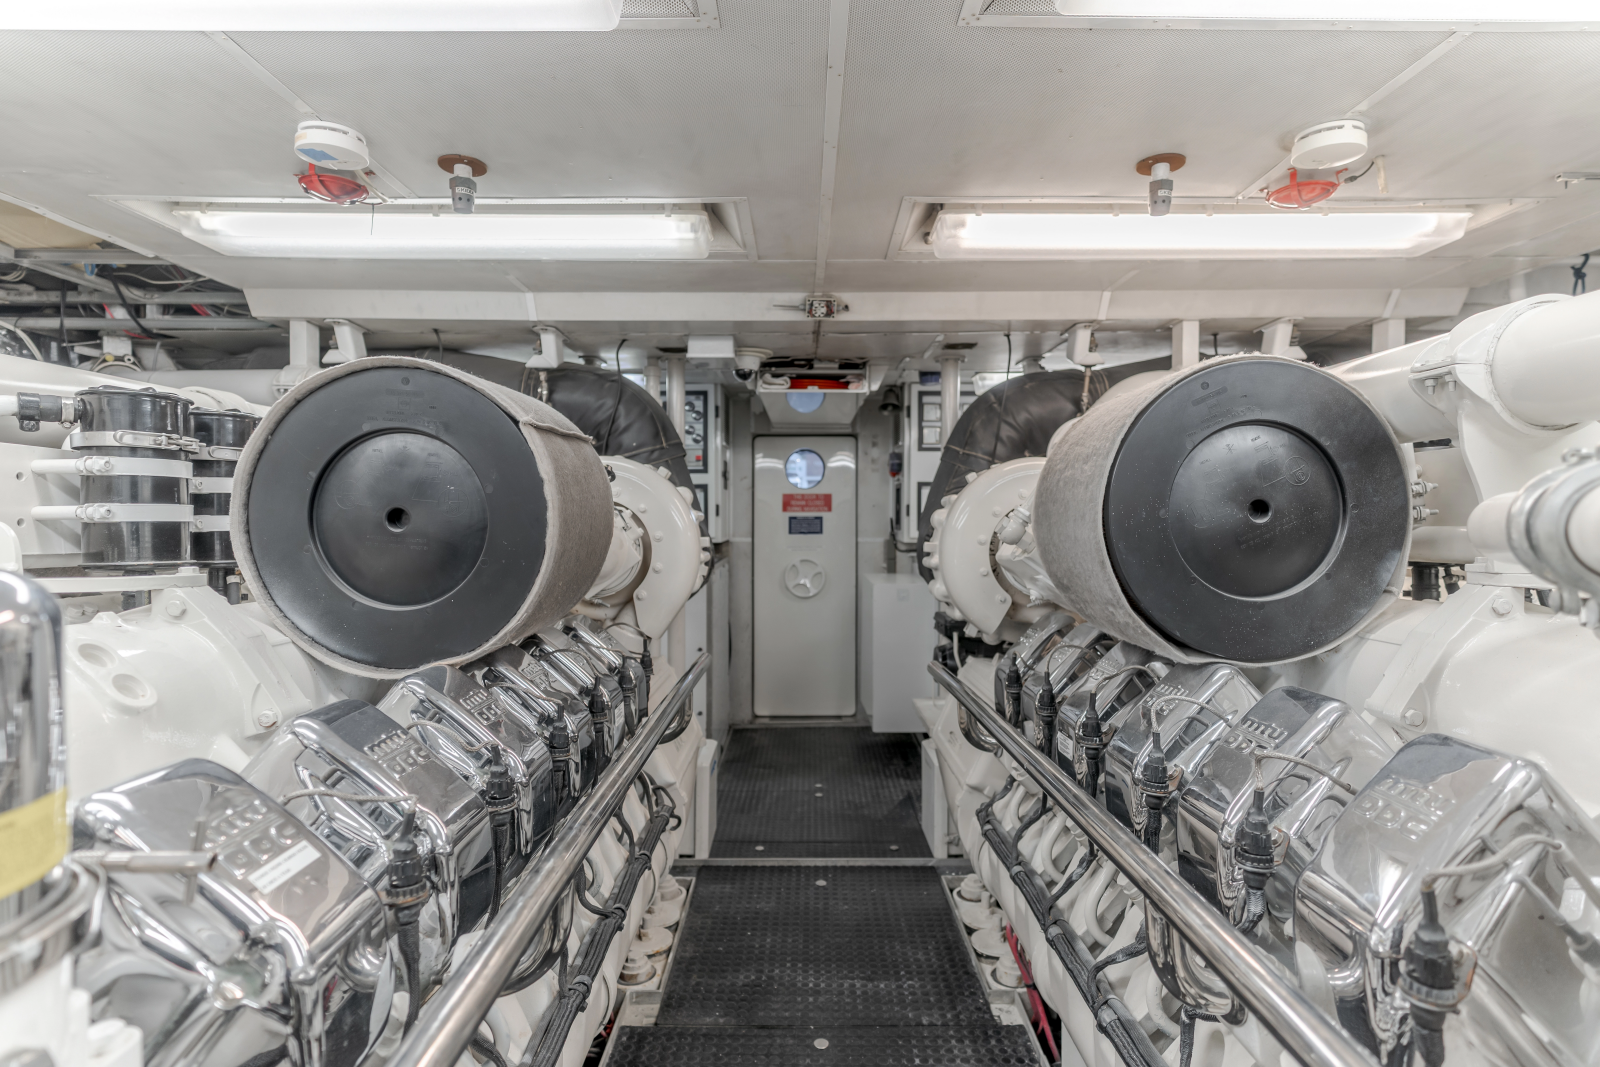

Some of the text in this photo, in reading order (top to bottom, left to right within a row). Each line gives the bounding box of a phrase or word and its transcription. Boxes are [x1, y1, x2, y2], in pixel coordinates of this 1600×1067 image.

[459, 688, 488, 709] mtu
[474, 700, 506, 726] DDC
[363, 727, 406, 760] mtu
[1241, 717, 1289, 744] mtu
[383, 743, 431, 782] DDC
[1374, 772, 1457, 818] mtu
[1352, 786, 1435, 843] DDC
[217, 817, 302, 881] DDC
